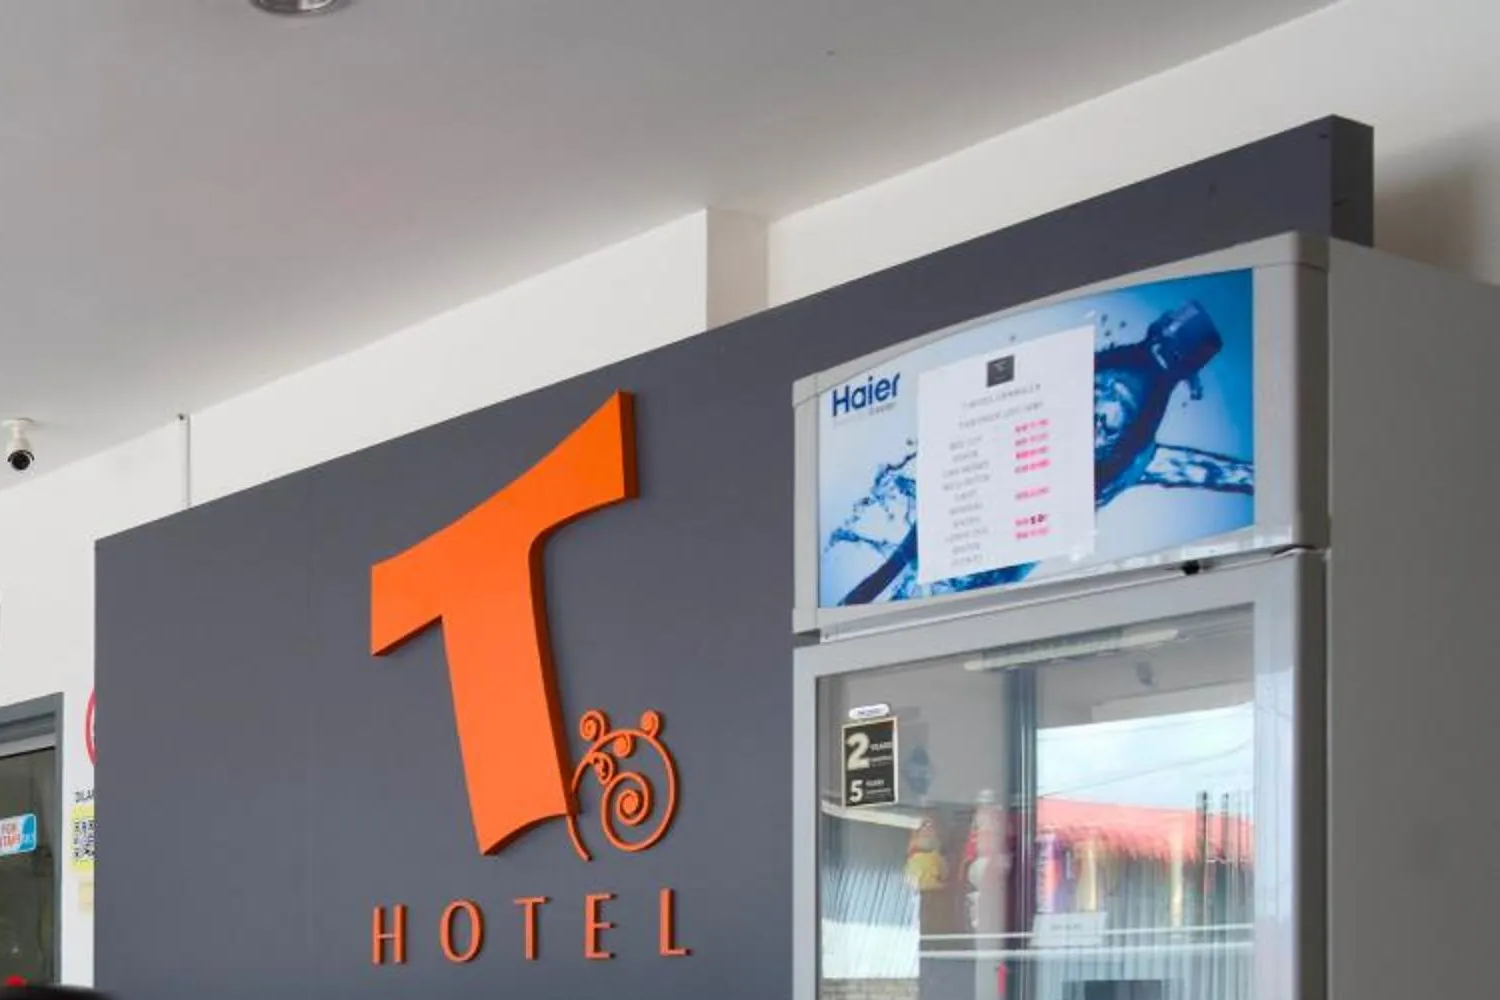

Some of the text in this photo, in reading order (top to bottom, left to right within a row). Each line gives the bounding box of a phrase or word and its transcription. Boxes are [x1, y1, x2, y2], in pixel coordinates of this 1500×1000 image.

[832, 372, 900, 417] Haier
[847, 732, 870, 771] 2
[849, 779, 863, 803] 5
[371, 888, 694, 966] HOTEL
